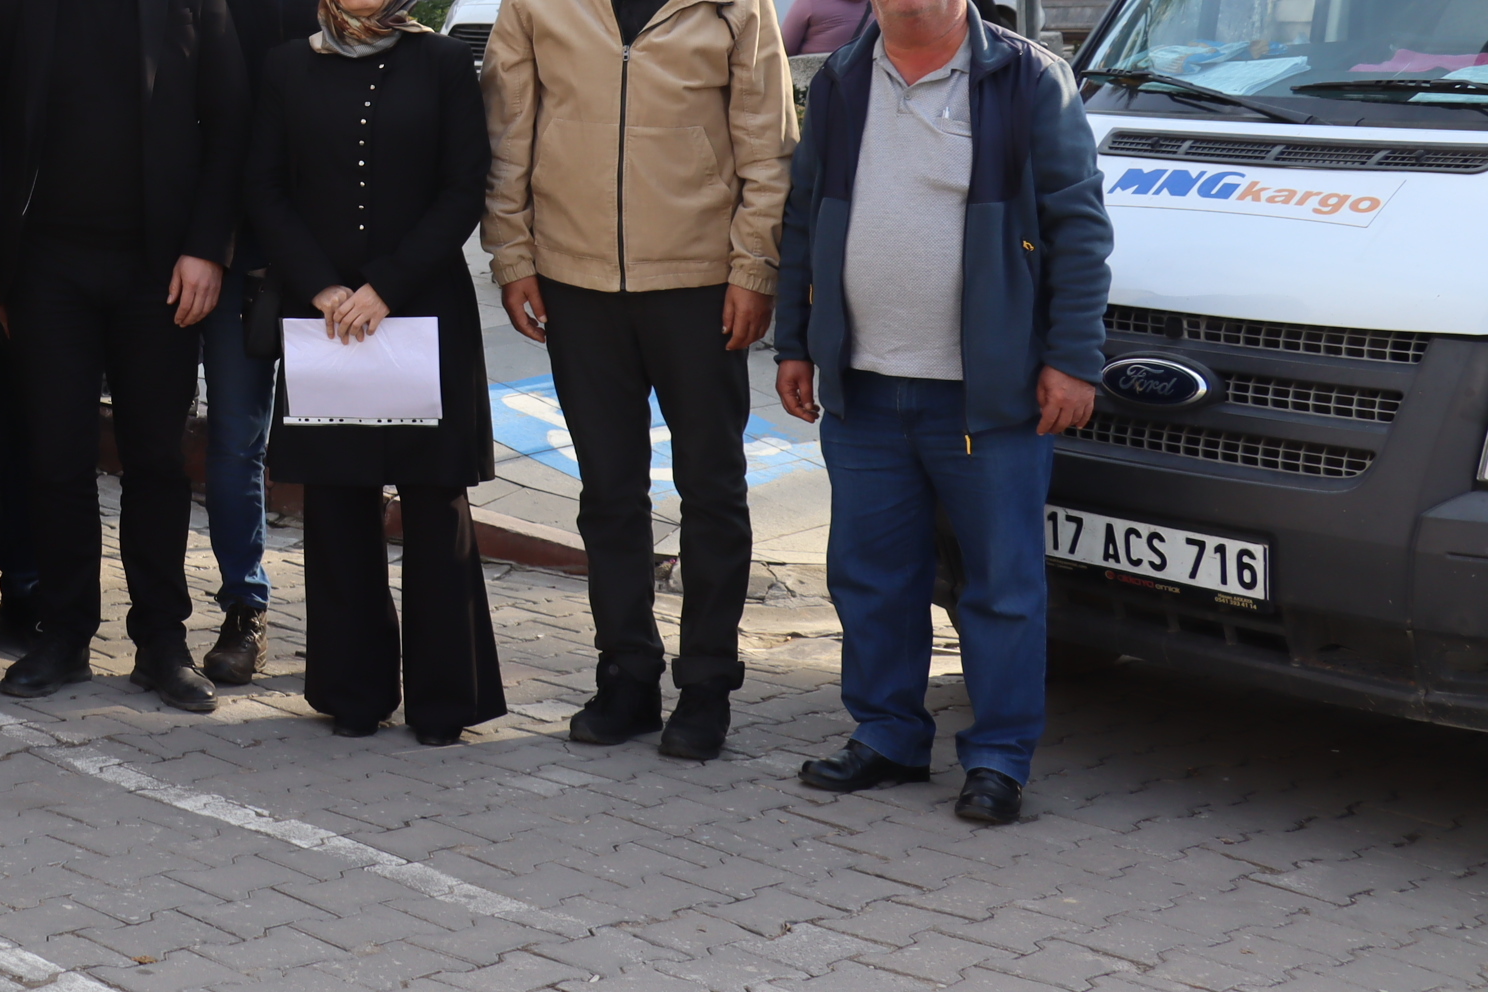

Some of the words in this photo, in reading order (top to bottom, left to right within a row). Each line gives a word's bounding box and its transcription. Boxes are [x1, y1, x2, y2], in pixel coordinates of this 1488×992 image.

[1107, 168, 1246, 200] MNG
[1235, 180, 1382, 216] kargo
[1119, 364, 1177, 396] Ford
[1047, 511, 1084, 555] 17
[1102, 522, 1168, 572] ACS
[1185, 537, 1258, 590] 716
